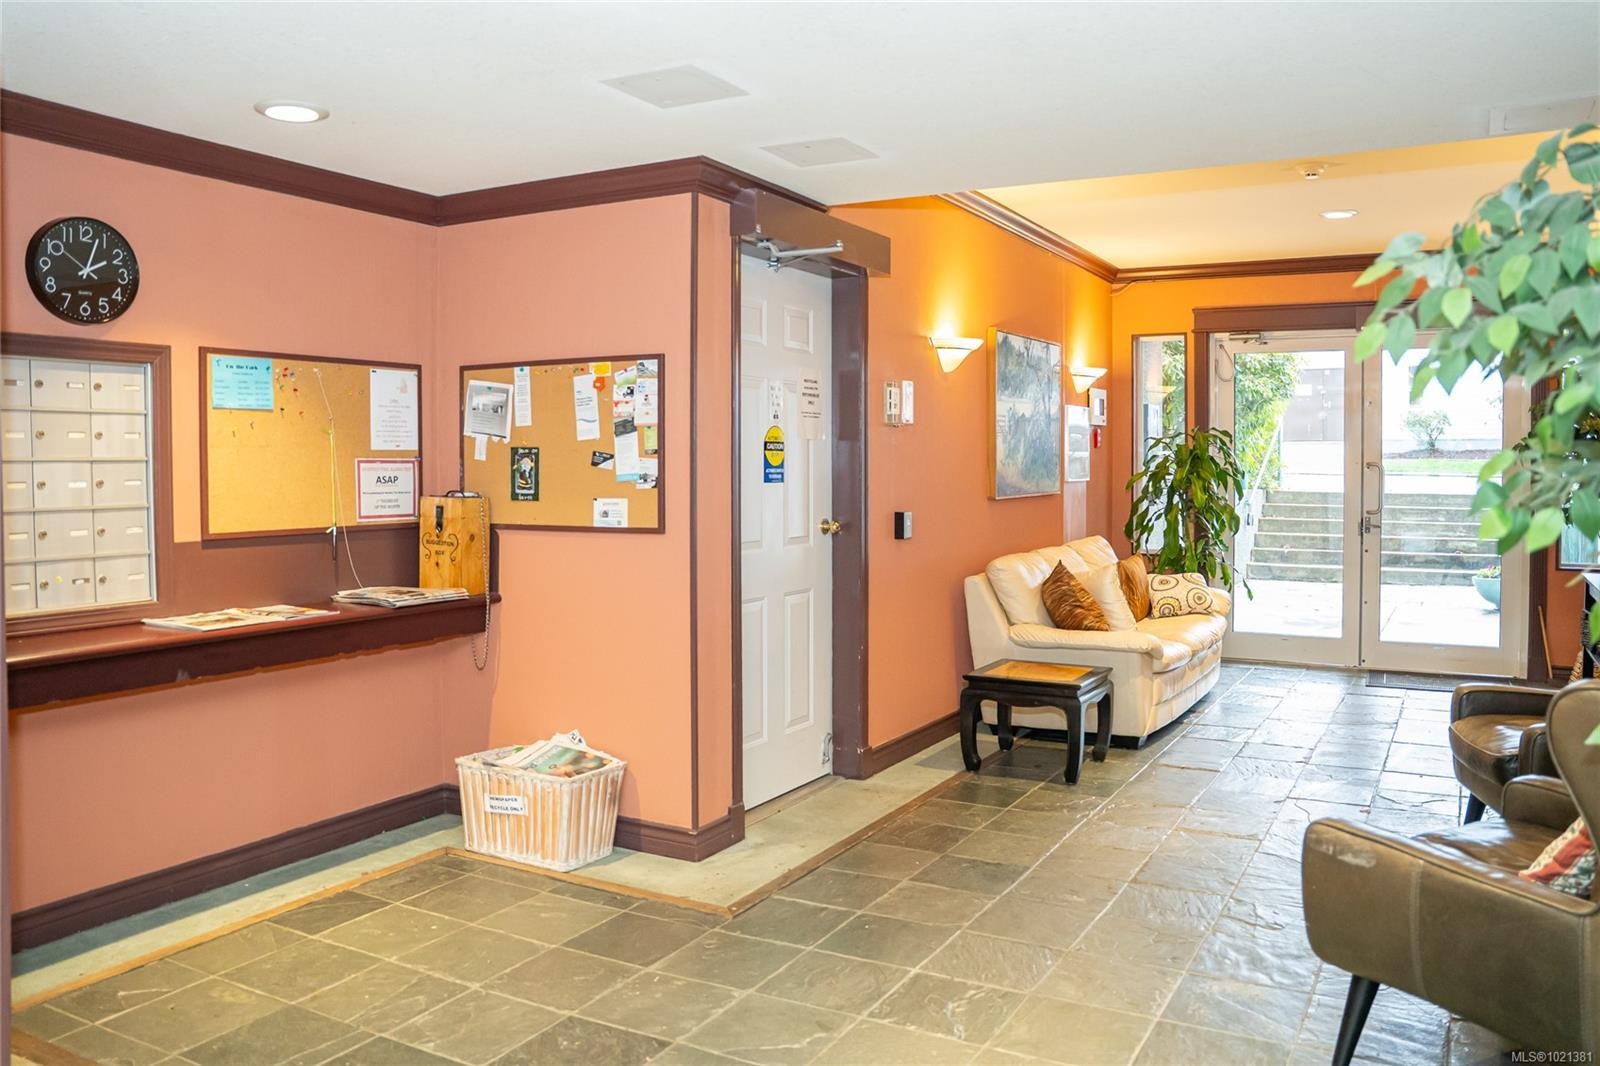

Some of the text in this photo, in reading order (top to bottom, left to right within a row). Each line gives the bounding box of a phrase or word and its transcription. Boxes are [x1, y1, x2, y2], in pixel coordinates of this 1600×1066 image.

[62, 226, 73, 243] 11
[79, 225, 93, 242] 12
[102, 233, 107, 249] 1
[46, 238, 64, 256] 10
[39, 257, 51, 272] 9
[112, 249, 123, 265] 2
[45, 276, 56, 293] 8
[118, 268, 129, 285] 3
[61, 292, 72, 309] 7
[112, 287, 122, 302] 4
[80, 301, 91, 316] 6
[98, 297, 109, 314] 5
[376, 475, 399, 484] ASAP
